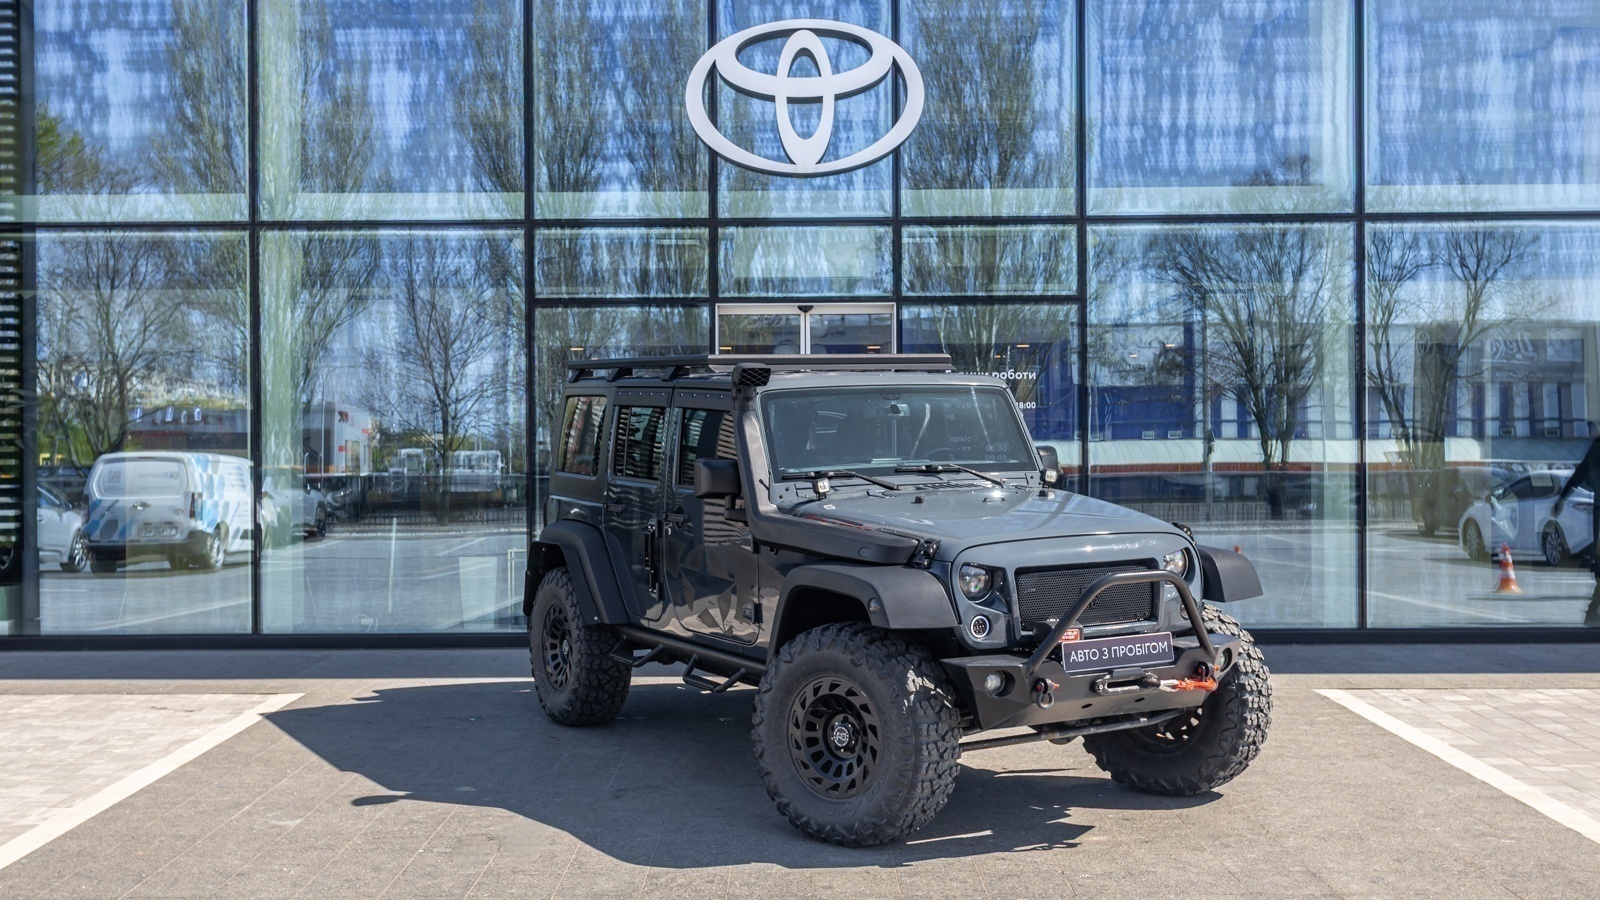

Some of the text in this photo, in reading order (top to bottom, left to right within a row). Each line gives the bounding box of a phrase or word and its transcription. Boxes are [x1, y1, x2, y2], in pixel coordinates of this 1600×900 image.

[949, 435, 971, 443] ервіс
[1070, 648, 1099, 662] АВТО
[1111, 641, 1168, 658] ПРОБІГОМ
